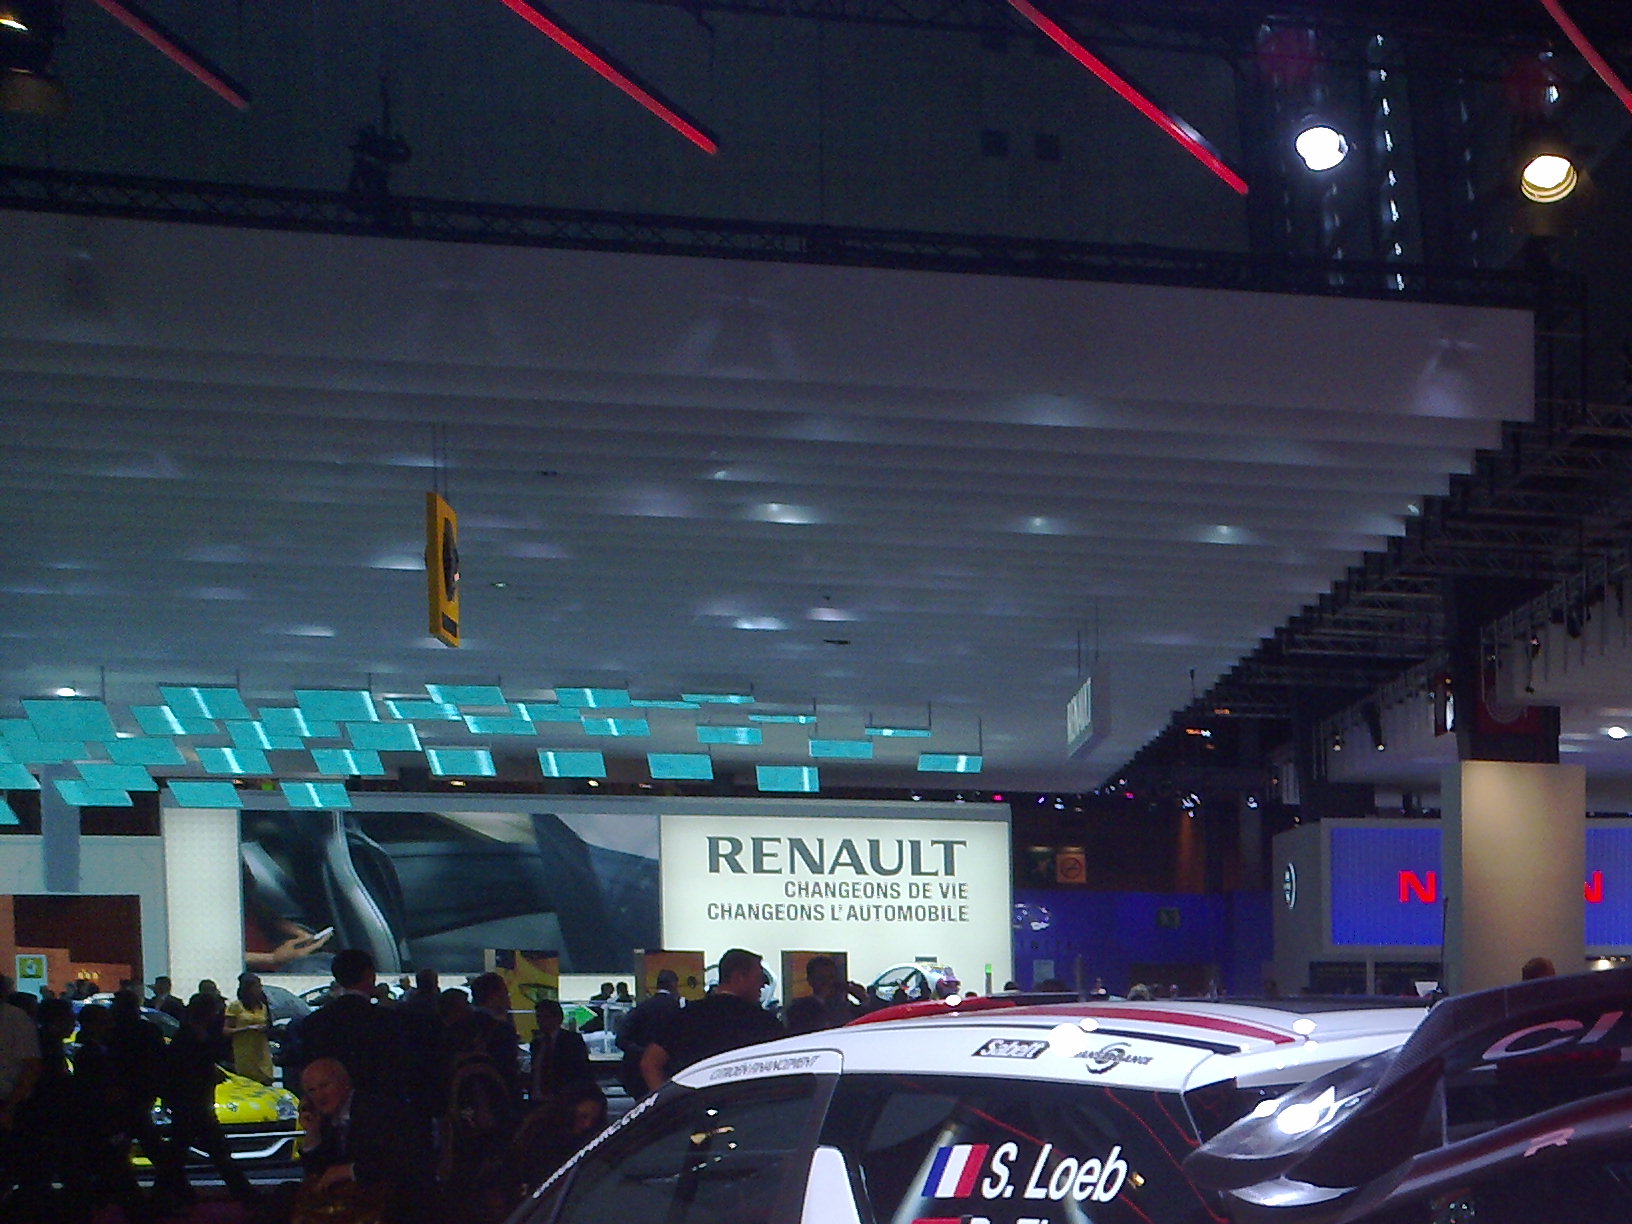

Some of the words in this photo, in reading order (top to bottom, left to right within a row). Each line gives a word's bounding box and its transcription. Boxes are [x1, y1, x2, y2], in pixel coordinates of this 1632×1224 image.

[706, 836, 967, 877] RENAULT
[784, 881, 901, 900] CHANGEONS
[908, 882, 932, 900] DE
[938, 883, 968, 900] VIE
[707, 903, 825, 921] CHANGEONS
[981, 1142, 1018, 1199] S.
[1024, 1143, 1128, 1202] Loeb
